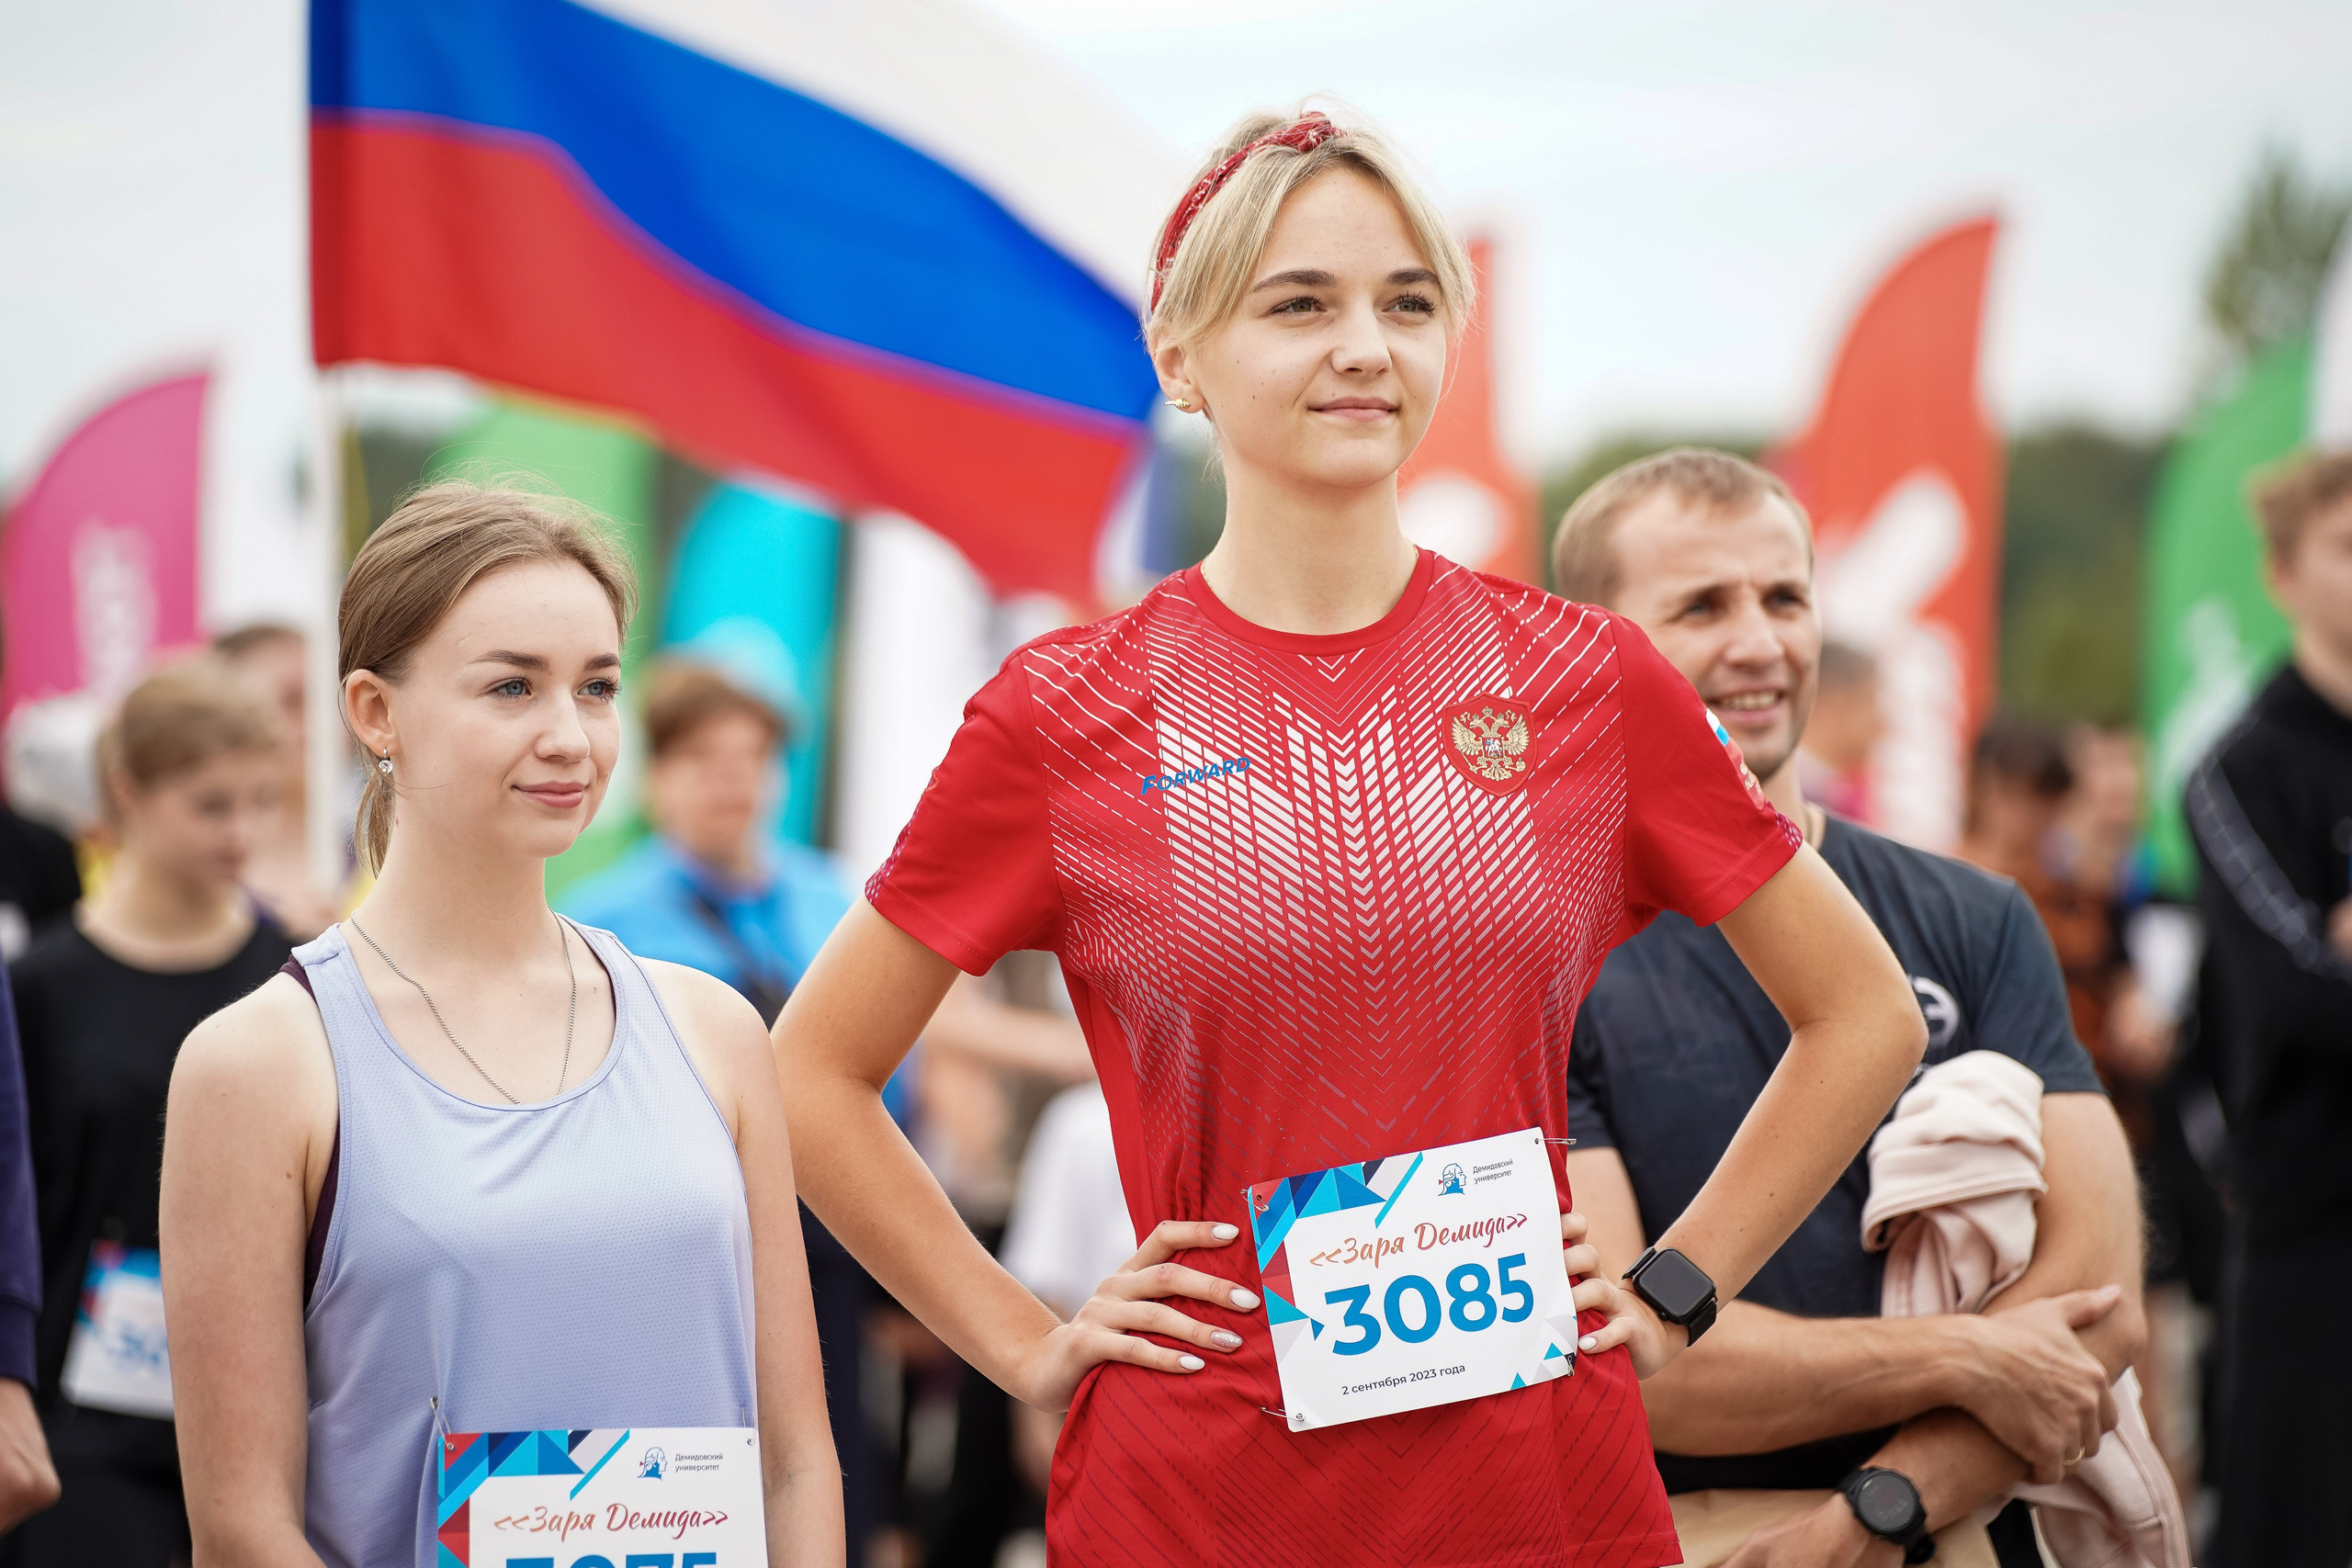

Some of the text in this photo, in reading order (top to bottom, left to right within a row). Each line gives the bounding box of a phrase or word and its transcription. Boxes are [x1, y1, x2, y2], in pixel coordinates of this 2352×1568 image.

[1141, 757, 1250, 795] FORWARD
[1472, 1158, 1514, 1175] Демидовский
[1474, 1169, 1512, 1185] университет
[1324, 1252, 1534, 1356] 3085
[1341, 1364, 1466, 1395] 2 сентября 2023 года
[674, 1452, 724, 1462] Демидовский
[674, 1464, 720, 1473] университет
